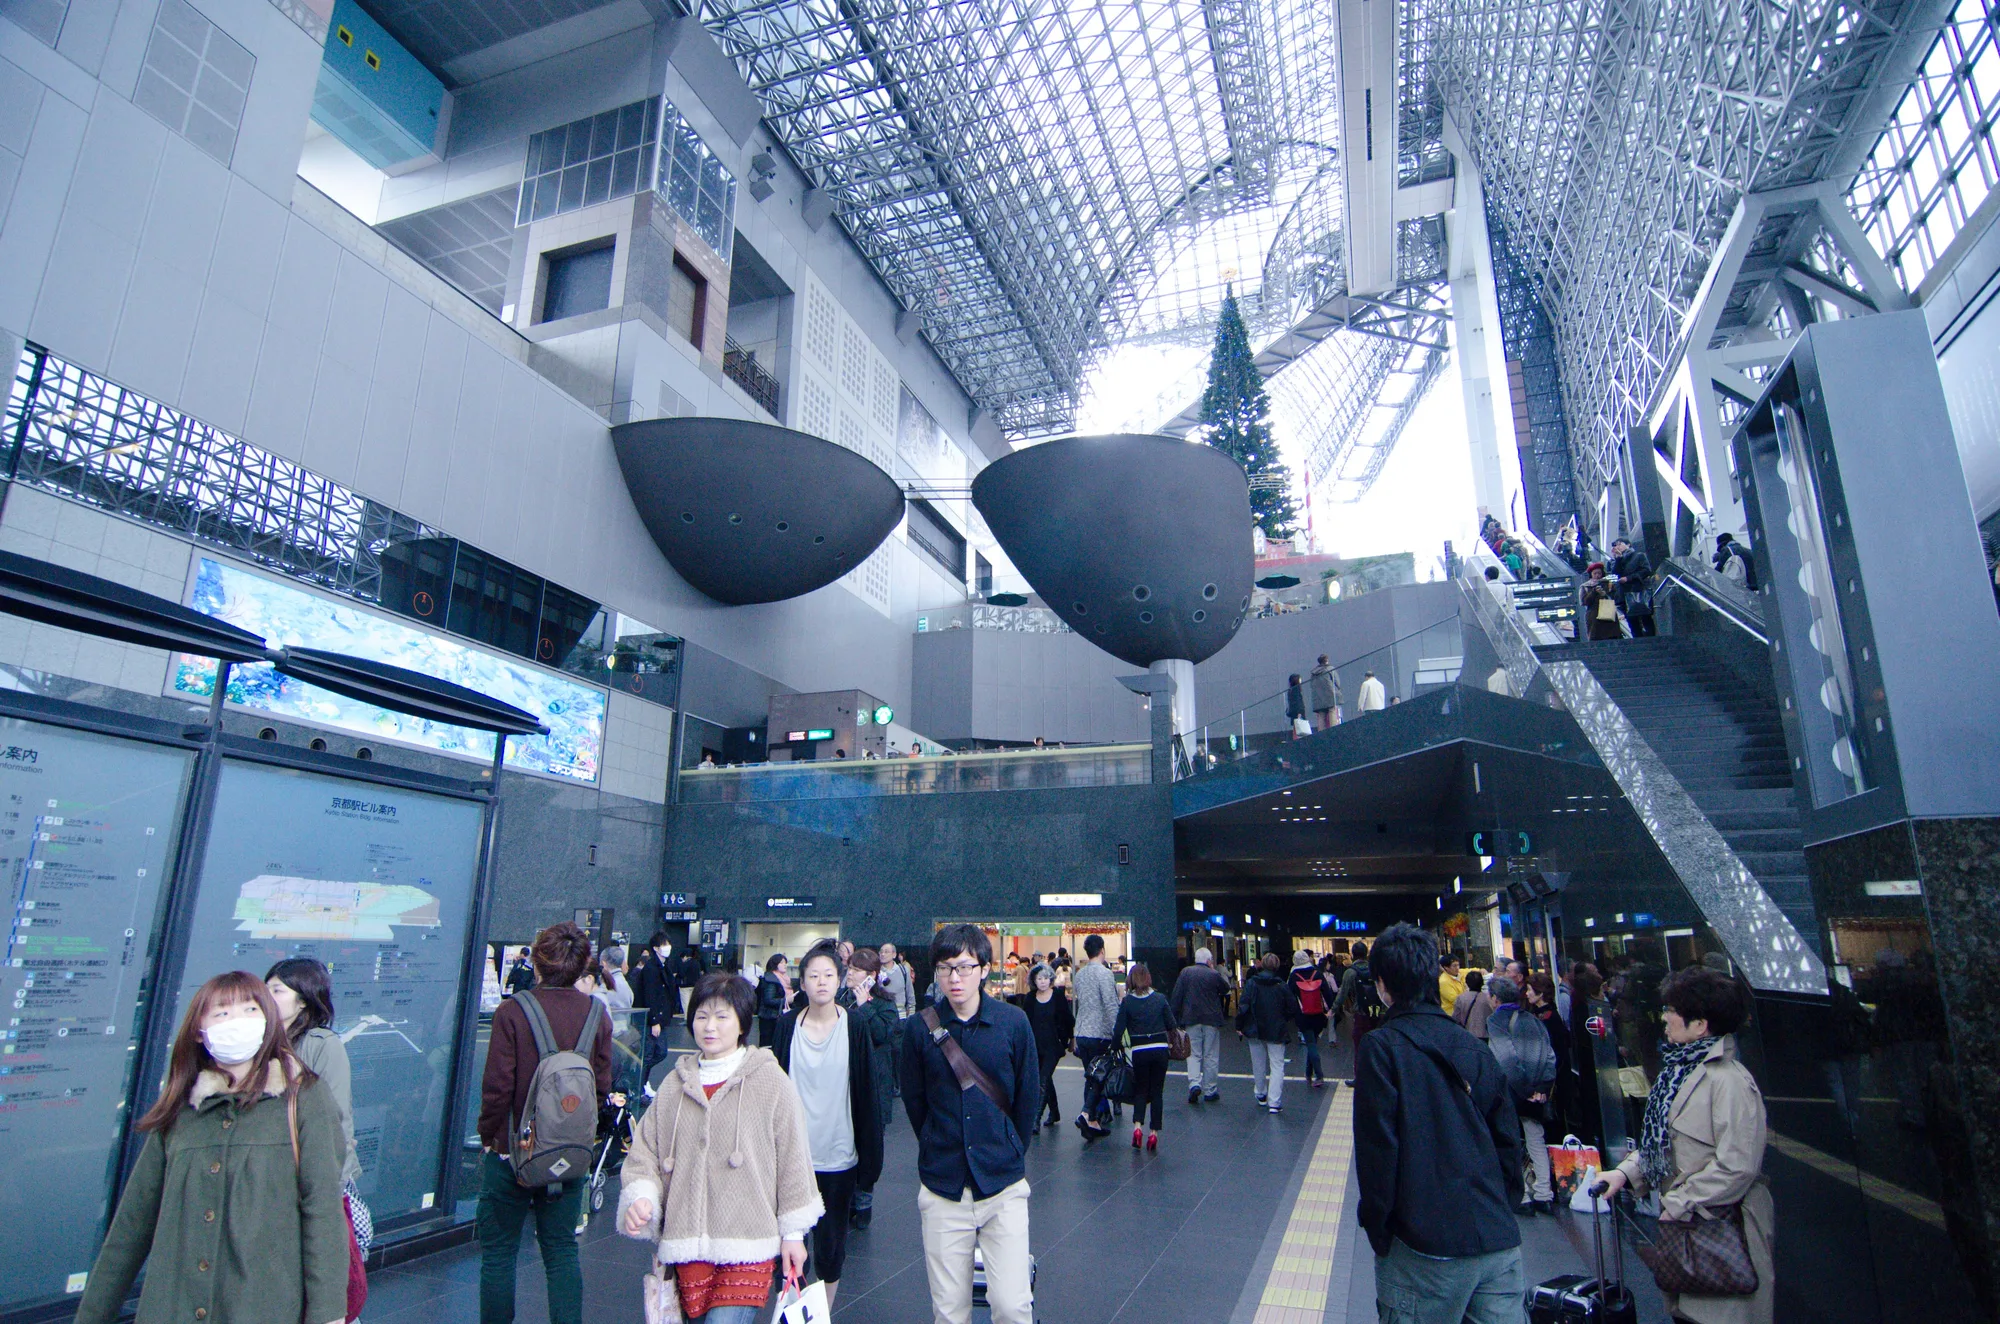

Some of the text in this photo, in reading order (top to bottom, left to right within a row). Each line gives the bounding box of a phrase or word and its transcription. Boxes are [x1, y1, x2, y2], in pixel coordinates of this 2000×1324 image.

[0, 761, 43, 774] nformation
[331, 797, 397, 817] 京都駅ビル案内
[1335, 919, 1367, 930] ISETAN
